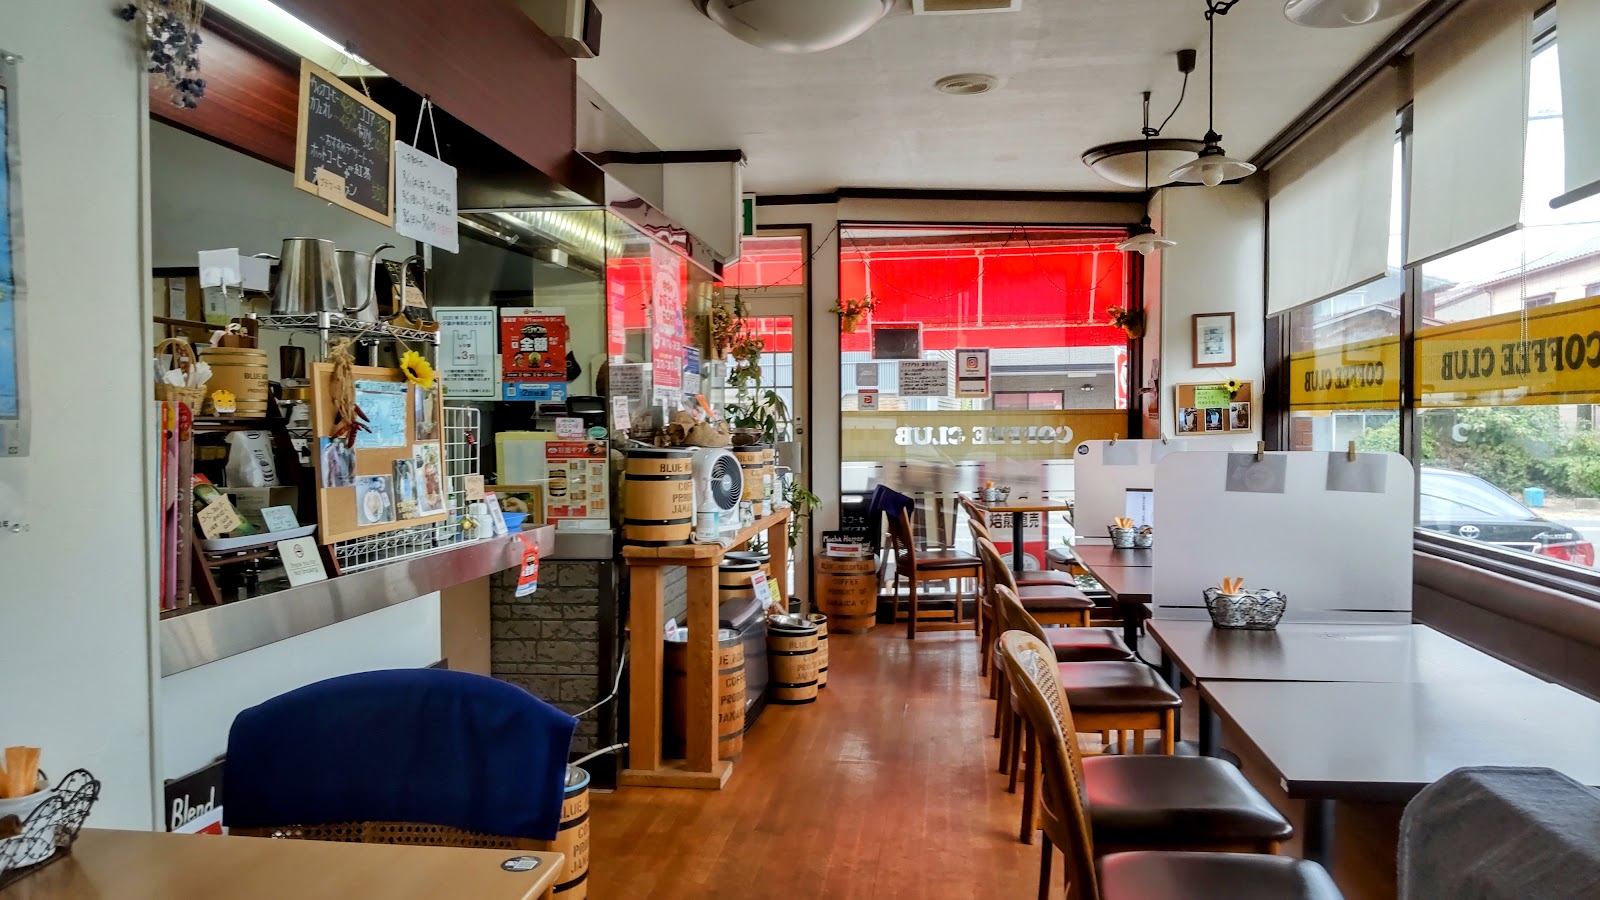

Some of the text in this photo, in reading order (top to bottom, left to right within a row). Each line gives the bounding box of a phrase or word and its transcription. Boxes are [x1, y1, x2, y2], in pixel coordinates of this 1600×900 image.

[520, 337, 548, 352] 全額
[660, 463, 682, 473] BLUE
[171, 786, 215, 832] Blend
